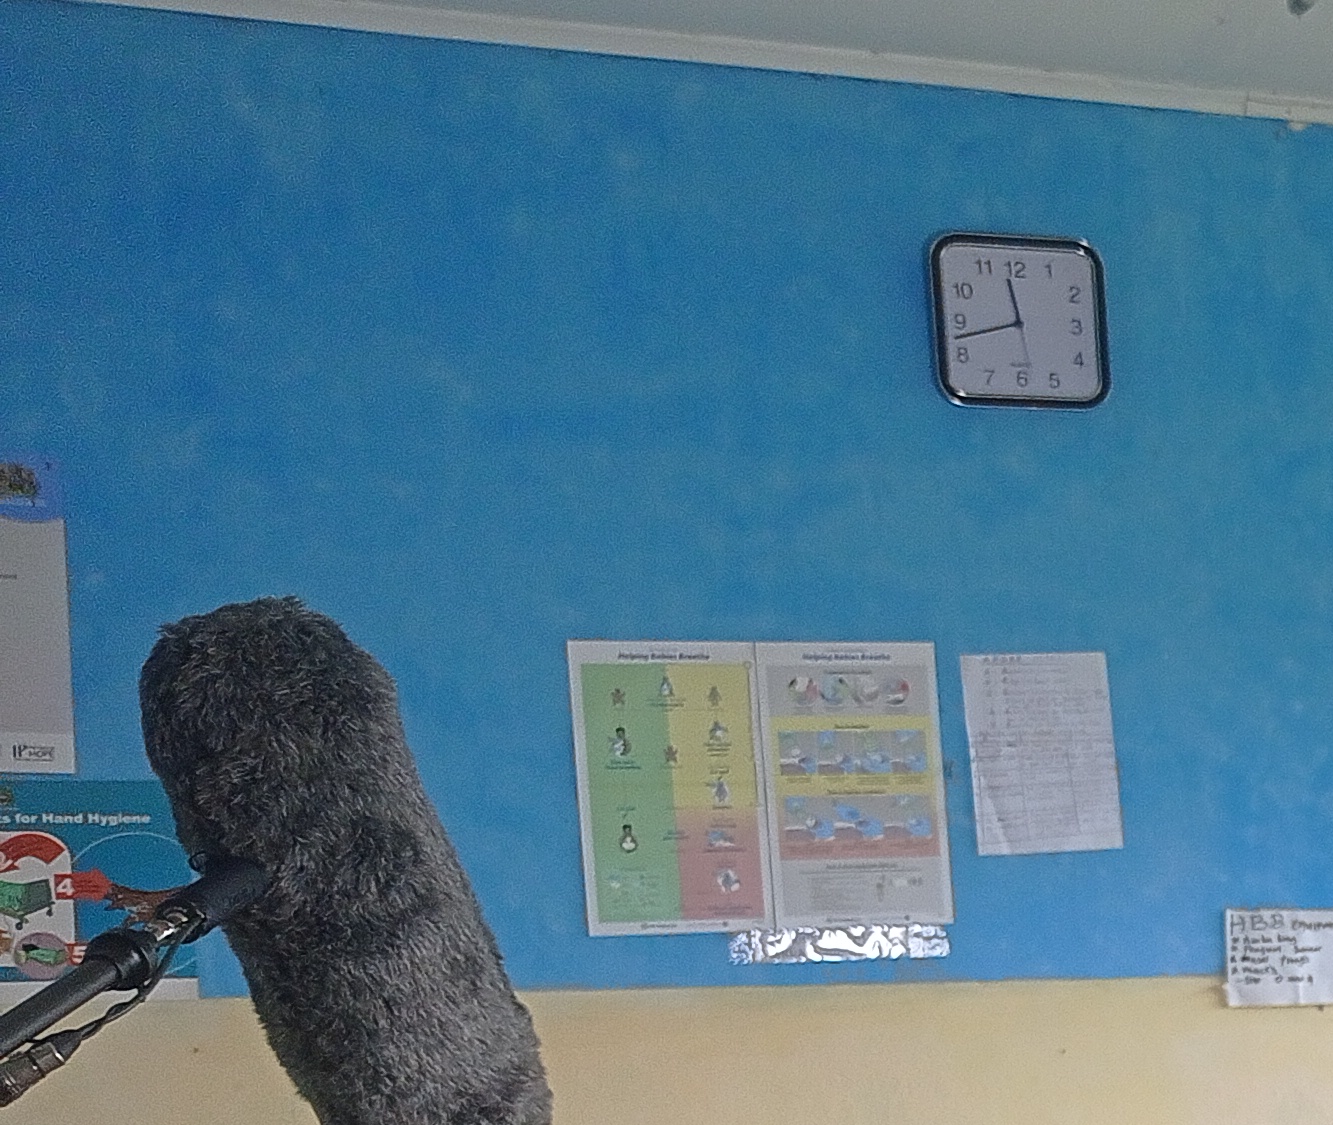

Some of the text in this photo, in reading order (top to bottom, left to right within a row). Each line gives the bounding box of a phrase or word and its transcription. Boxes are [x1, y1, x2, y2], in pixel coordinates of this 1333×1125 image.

[975, 259, 992, 275] 11
[1005, 261, 1026, 279] 12
[1044, 264, 1053, 278] 1
[953, 282, 973, 300] 10
[1069, 286, 1081, 303] 2
[954, 313, 966, 330] 9
[1071, 319, 1083, 336] 3
[957, 347, 969, 364] 8
[1073, 352, 1084, 368] 4
[984, 370, 995, 385] 7
[1016, 371, 1028, 388] 6
[1050, 373, 1060, 389] 5
[15, 813, 38, 824] for
[42, 813, 83, 824] Hand
[87, 813, 151, 827] Hygiene
[56, 877, 75, 896] 4
[71, 945, 88, 964] 5
